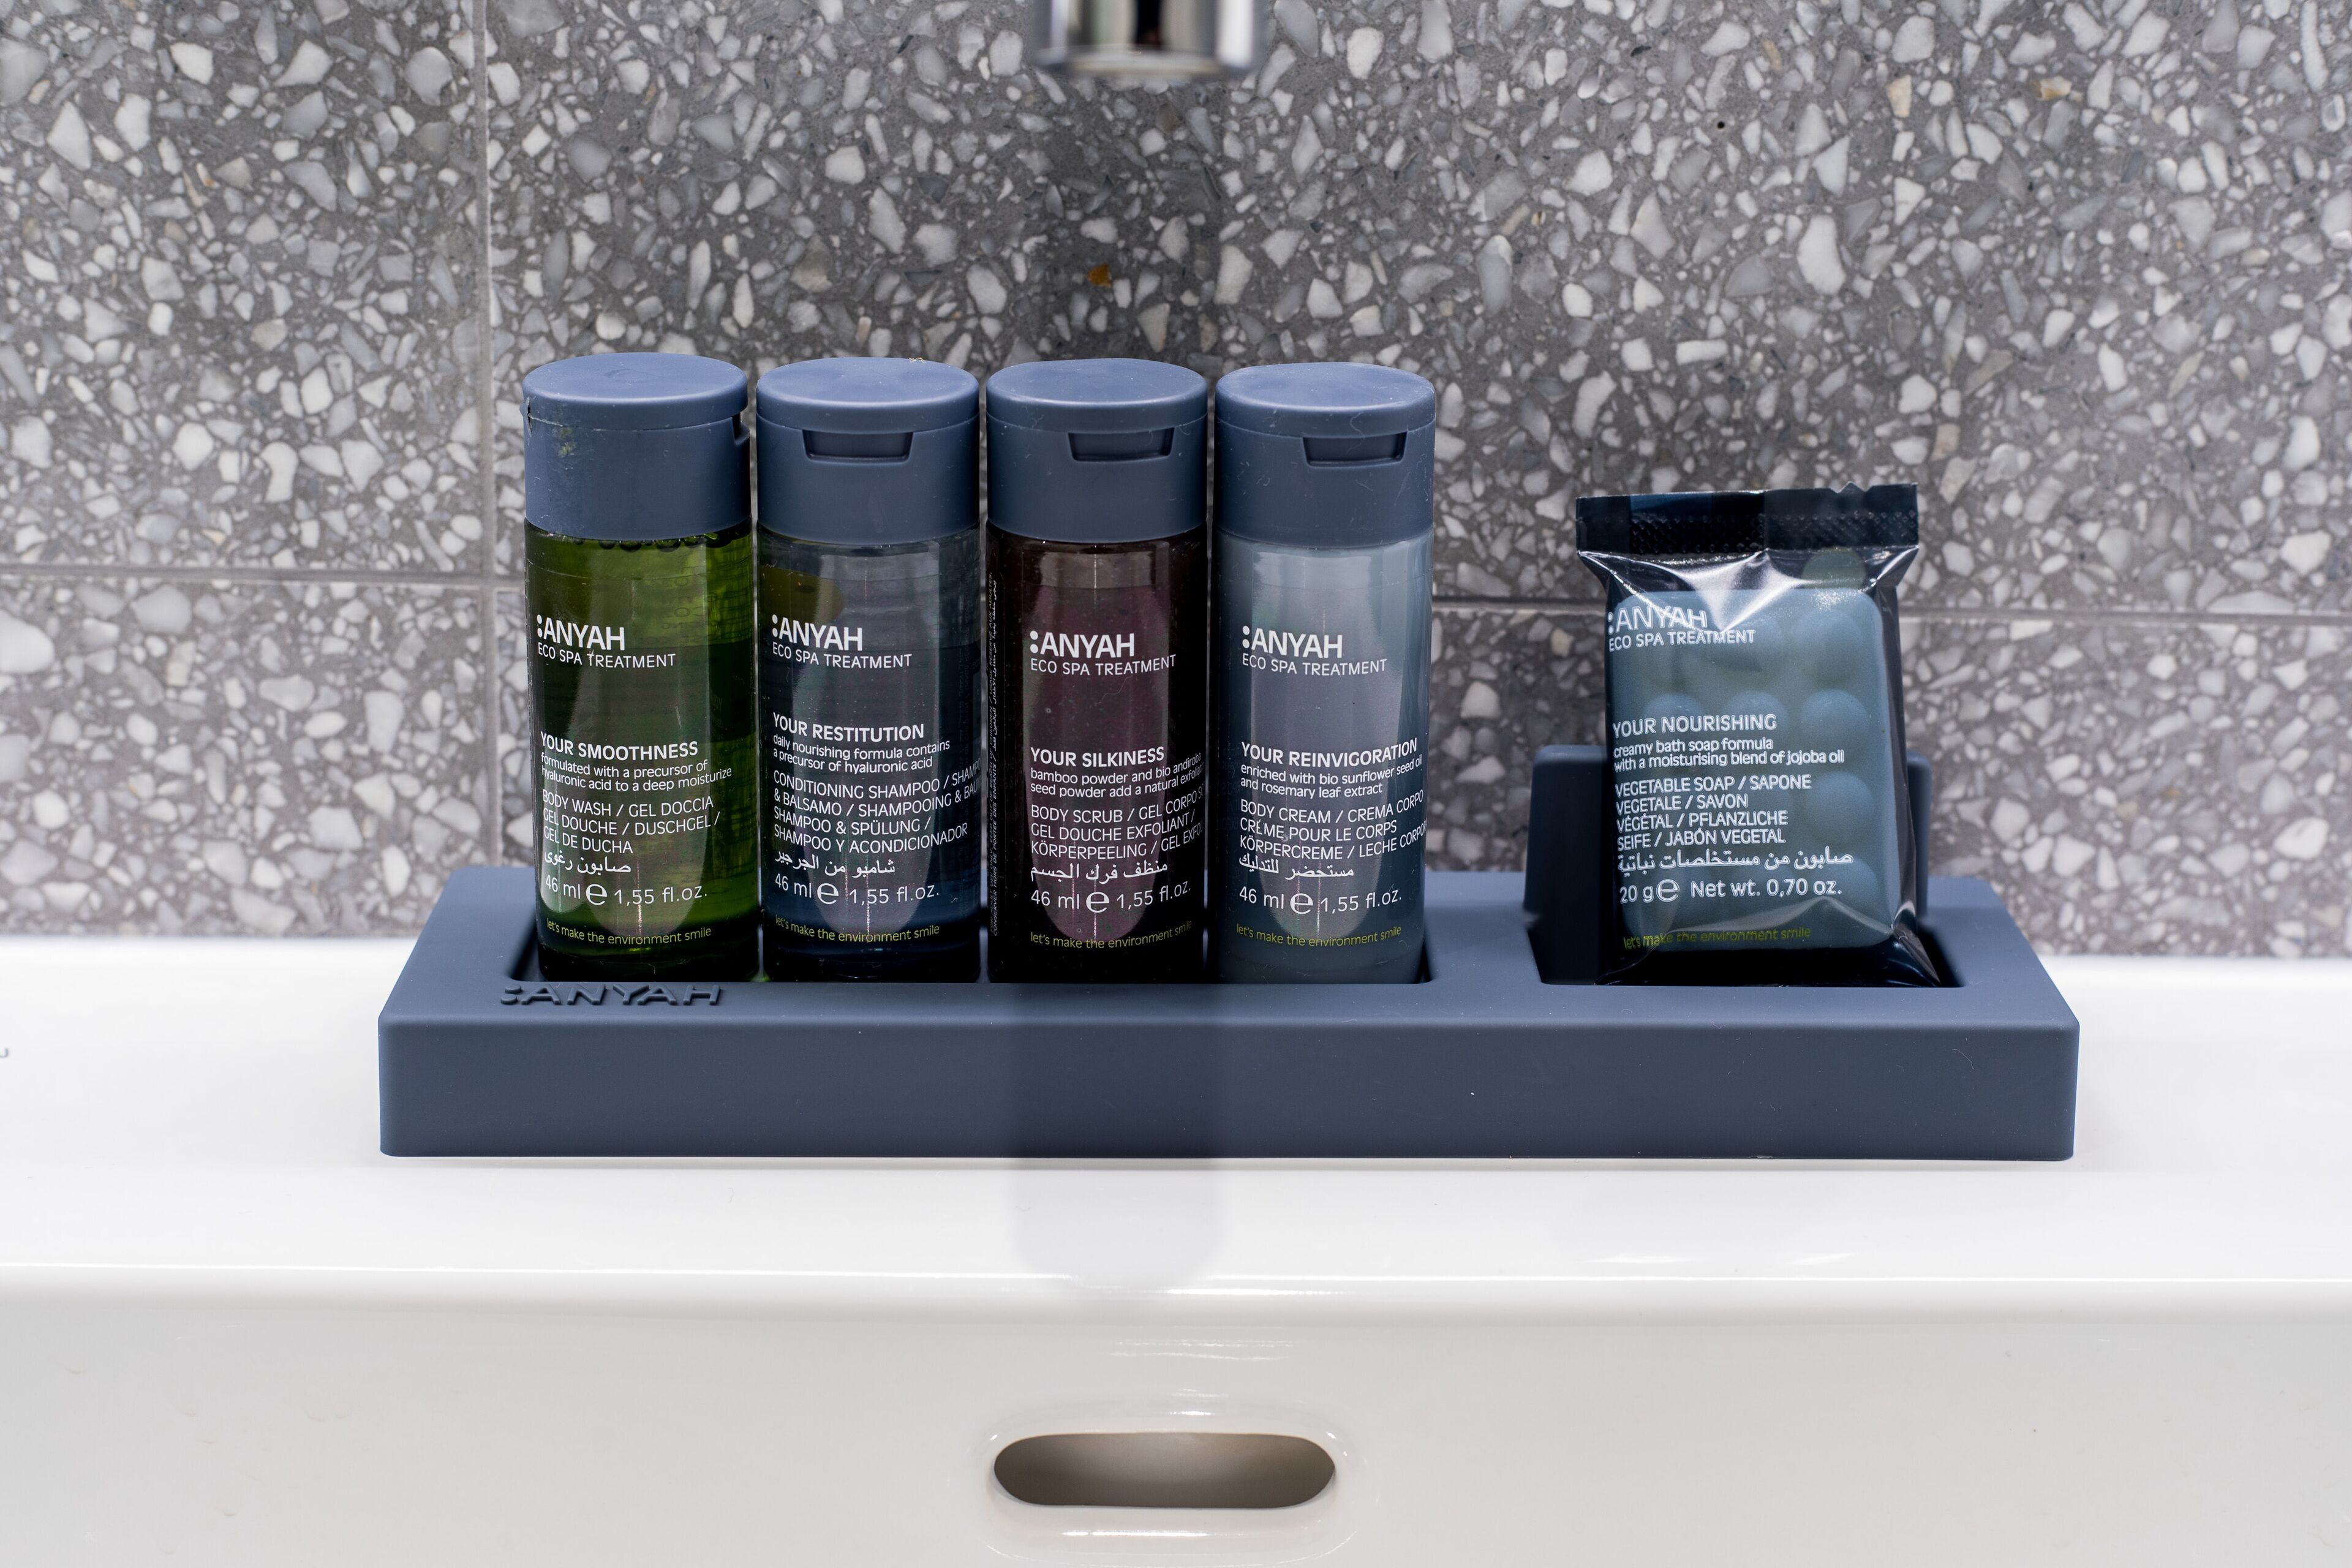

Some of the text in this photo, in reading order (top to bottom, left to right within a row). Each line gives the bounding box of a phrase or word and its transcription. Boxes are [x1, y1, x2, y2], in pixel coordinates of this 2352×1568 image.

[1609, 630, 1756, 652] ECO SPA TREATMENT
[538, 642, 676, 668] ECO SPA TREATMENT
[773, 642, 912, 668] ECO SPA TREATMENT
[1031, 654, 1176, 675] ECO SPA TREATMENT
[1243, 653, 1387, 676] ECO SPA TREATMENT
[774, 712, 924, 742] YOUR RESTITUTION
[1613, 714, 1777, 738] YOUR NOURISHING
[541, 731, 698, 760] YOUR SMOOTHNESS
[774, 734, 950, 760] daily nourishing formula contains
[1031, 747, 1164, 768] YOUR SILKINESS
[1242, 737, 1417, 767] YOUR REINVIGORATION
[1613, 737, 1773, 758] creamy bath soap formula
[541, 752, 590, 775] formulated
[594, 766, 619, 777] with
[634, 764, 693, 779] precursor
[696, 760, 707, 771] of
[1241, 764, 1286, 782] enriched
[1289, 772, 1315, 784] with
[1319, 774, 1338, 785] bio
[1342, 768, 1395, 784] sunflower
[1396, 758, 1414, 775] seed
[1614, 750, 1844, 772] with a moisturising blend of jojoba oil
[542, 765, 586, 788] hyaluronic
[589, 779, 611, 790] acid
[615, 781, 628, 791] to
[643, 780, 674, 791] deep
[679, 764, 731, 788] moisturize
[774, 771, 940, 799] CONDITIONING SHAMPOO
[1031, 767, 1077, 783] bamboo
[1082, 773, 1128, 785] powder
[1132, 769, 1152, 782] and
[1156, 766, 1170, 778] bio
[1241, 778, 1383, 799] and rosemary leaf extract
[1615, 777, 1691, 797] VEGETABLE
[1694, 776, 1735, 791] SOAP
[1749, 774, 1812, 790] SAPONE
[543, 787, 568, 809] BODY
[572, 799, 611, 816] WASH
[629, 804, 656, 817] GEL
[662, 796, 714, 815] DOCCIA
[1031, 804, 1068, 821] BODY
[1073, 810, 1122, 823] SCRUB
[1139, 804, 1162, 820] GEL
[1166, 791, 1196, 814] CORPO
[1241, 799, 1275, 821] BODY
[1279, 808, 1330, 823] CREAM
[1348, 804, 1393, 822] CREMA
[1396, 790, 1423, 813] CORPO
[1616, 796, 1681, 815] VEGETALE
[1697, 793, 1748, 809] SAVON
[543, 808, 559, 825] GEL
[562, 815, 617, 835] DOUCHE
[635, 815, 710, 835] DUSCHGEL
[774, 806, 831, 832] SHAMPOO
[836, 821, 846, 834] &
[851, 819, 920, 835] SPÜLUNG
[1031, 823, 1055, 839] GEL
[1060, 827, 1121, 841] DOUCHE
[1127, 812, 1189, 839] EXFOLIANT
[1616, 813, 1673, 833] VÉGÉTAL
[1689, 810, 1788, 827] PFLANZLICHE
[544, 826, 633, 853] GEL DE DUCHA
[775, 820, 967, 853] SHAMPOO Y ACONDICIONADOR
[1618, 833, 1651, 851] SEIFE
[1665, 827, 1717, 846] JABÓN
[1721, 828, 1786, 844] VEGETAL
[546, 875, 558, 892] 46
[564, 884, 580, 899] ml
[614, 889, 654, 906] 1,55
[1620, 885, 1637, 903] 20
[1643, 886, 1654, 903] g
[1691, 880, 1725, 898] Net
[1730, 880, 1760, 897] wt.
[1766, 878, 1807, 897] 0,70
[1813, 881, 1842, 895] oz.
[562, 927, 584, 940] make
[587, 932, 605, 943] the
[608, 933, 681, 944] environment
[685, 927, 711, 940] smile
